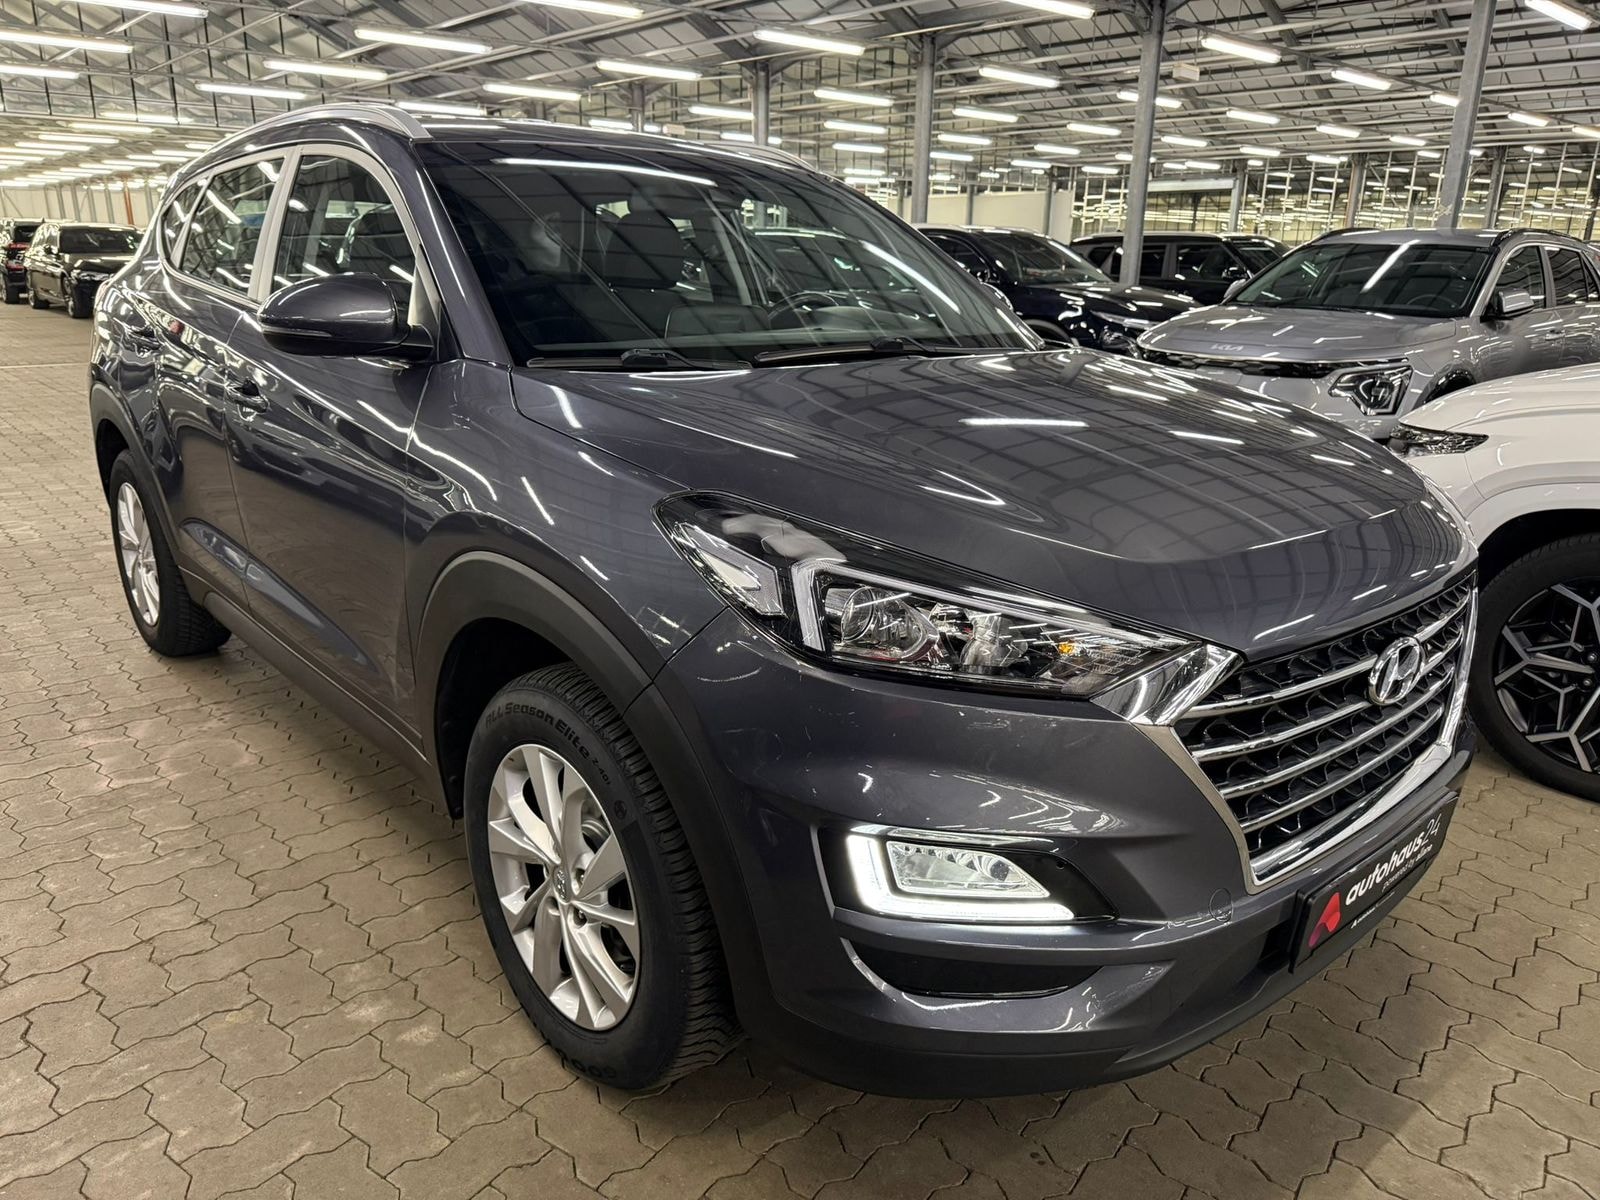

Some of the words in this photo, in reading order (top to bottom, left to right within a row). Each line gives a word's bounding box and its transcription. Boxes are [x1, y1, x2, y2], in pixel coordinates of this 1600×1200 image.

[505, 702, 555, 726] Season
[554, 719, 591, 759] Elite
[1345, 813, 1442, 906] autohaus24
